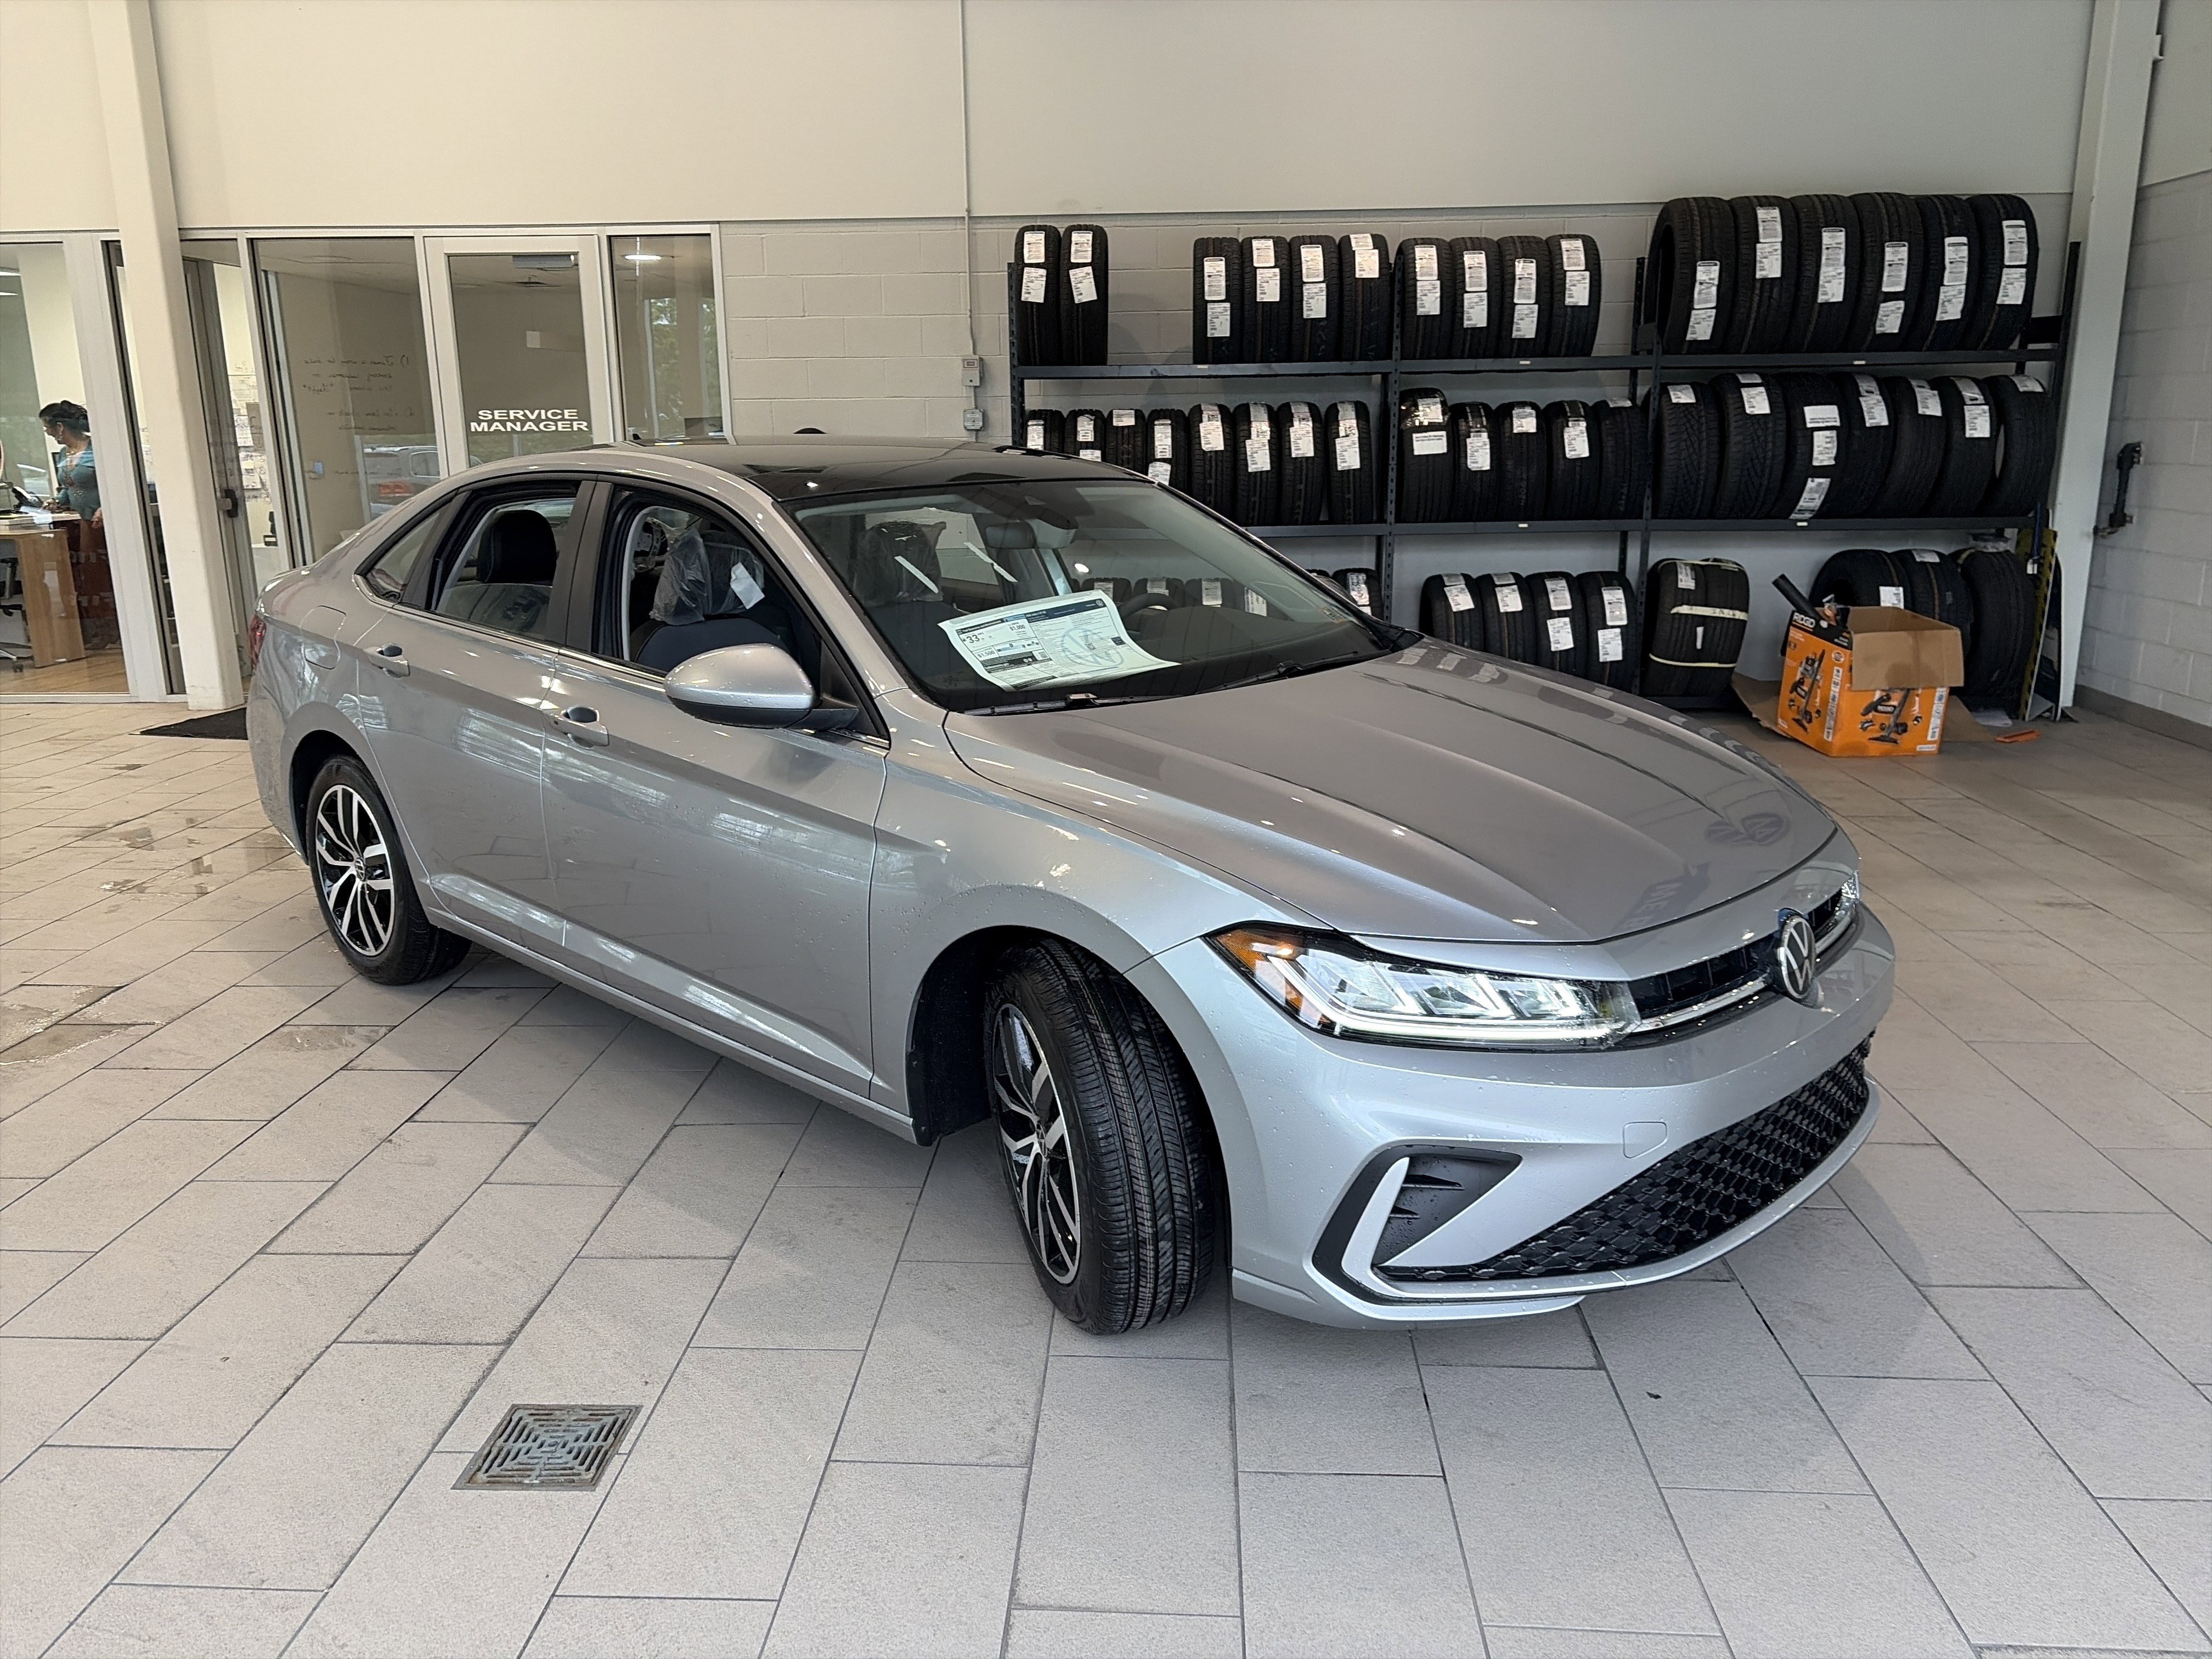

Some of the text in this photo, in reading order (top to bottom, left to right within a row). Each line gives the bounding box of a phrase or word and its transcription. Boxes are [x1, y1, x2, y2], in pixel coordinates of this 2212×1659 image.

[478, 409, 578, 420] SERVICE
[470, 421, 589, 432] MANAGER
[966, 634, 980, 644] 33
